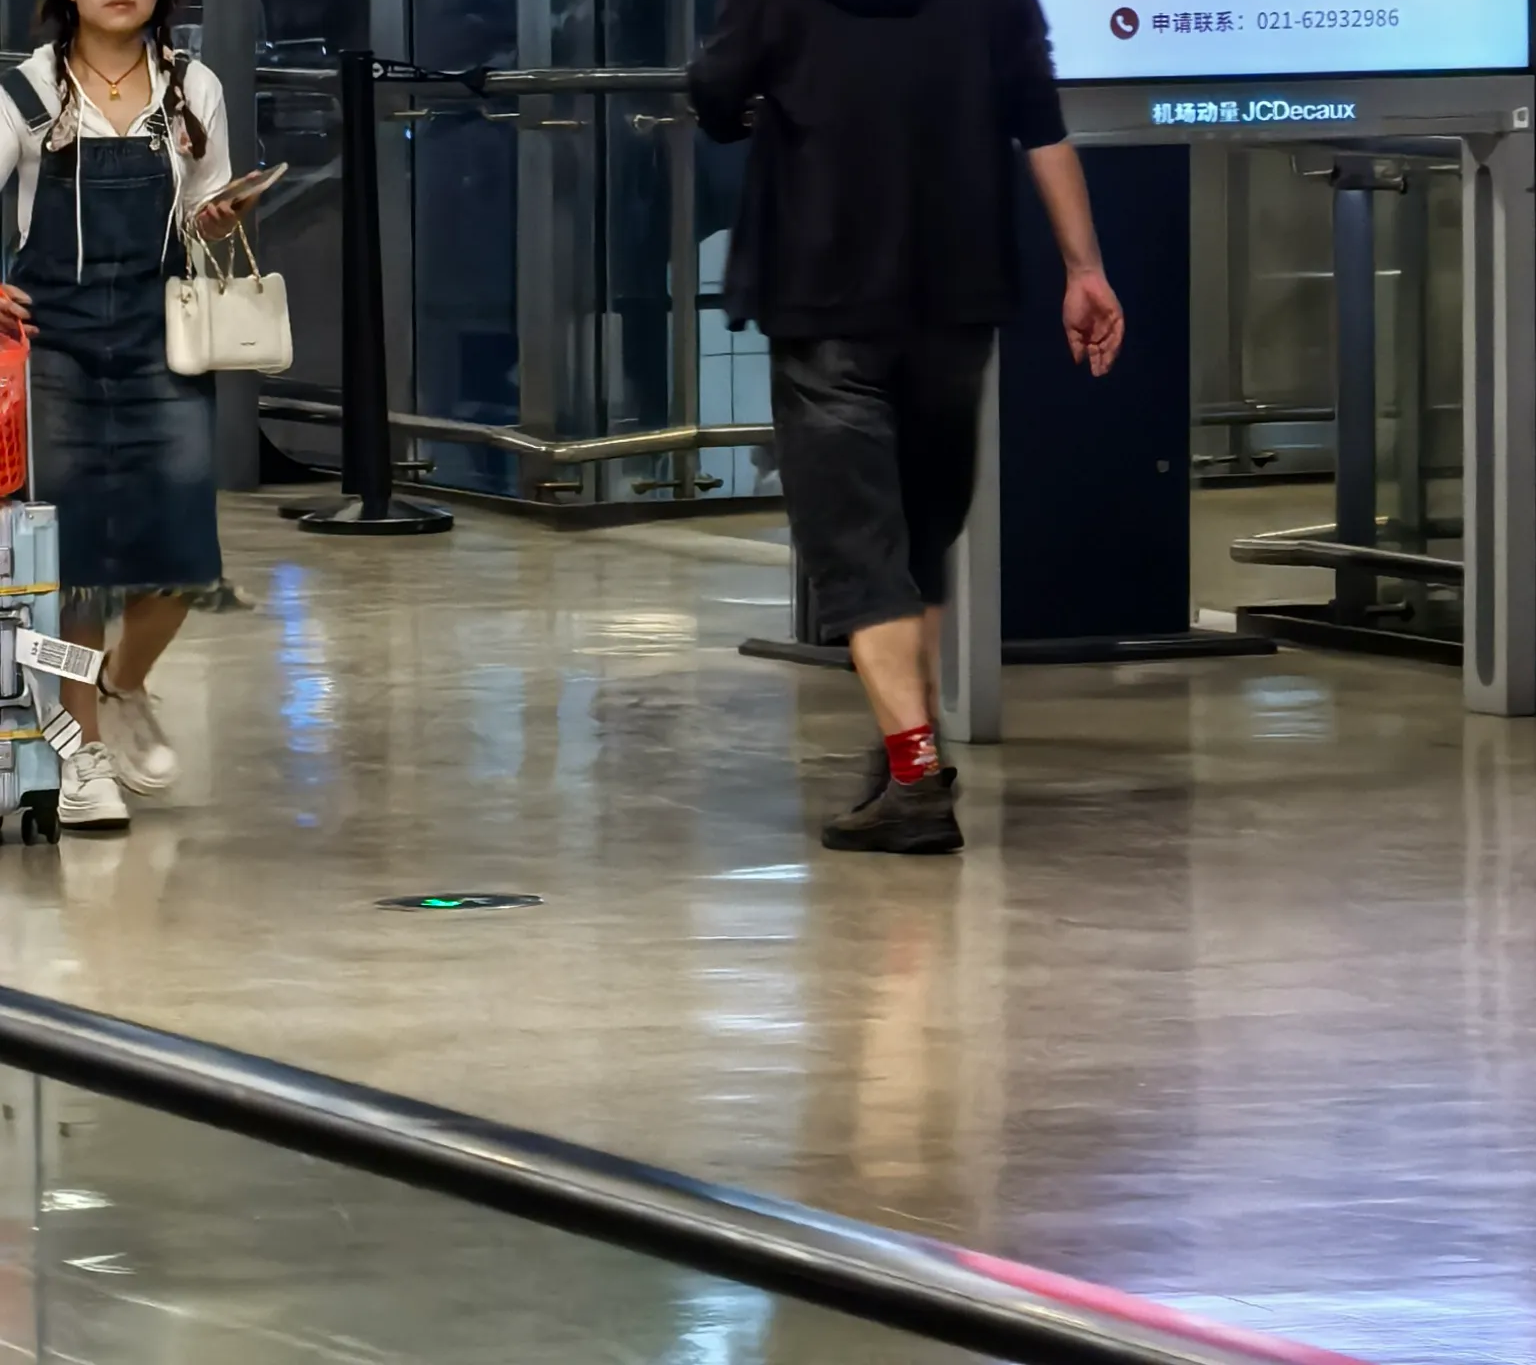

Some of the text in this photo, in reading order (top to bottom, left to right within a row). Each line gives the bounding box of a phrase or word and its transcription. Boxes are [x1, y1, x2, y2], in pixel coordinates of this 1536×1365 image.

[1256, 8, 1400, 31] 021-62932986
[1152, 100, 1356, 124] 机场动量 JCDecaux
